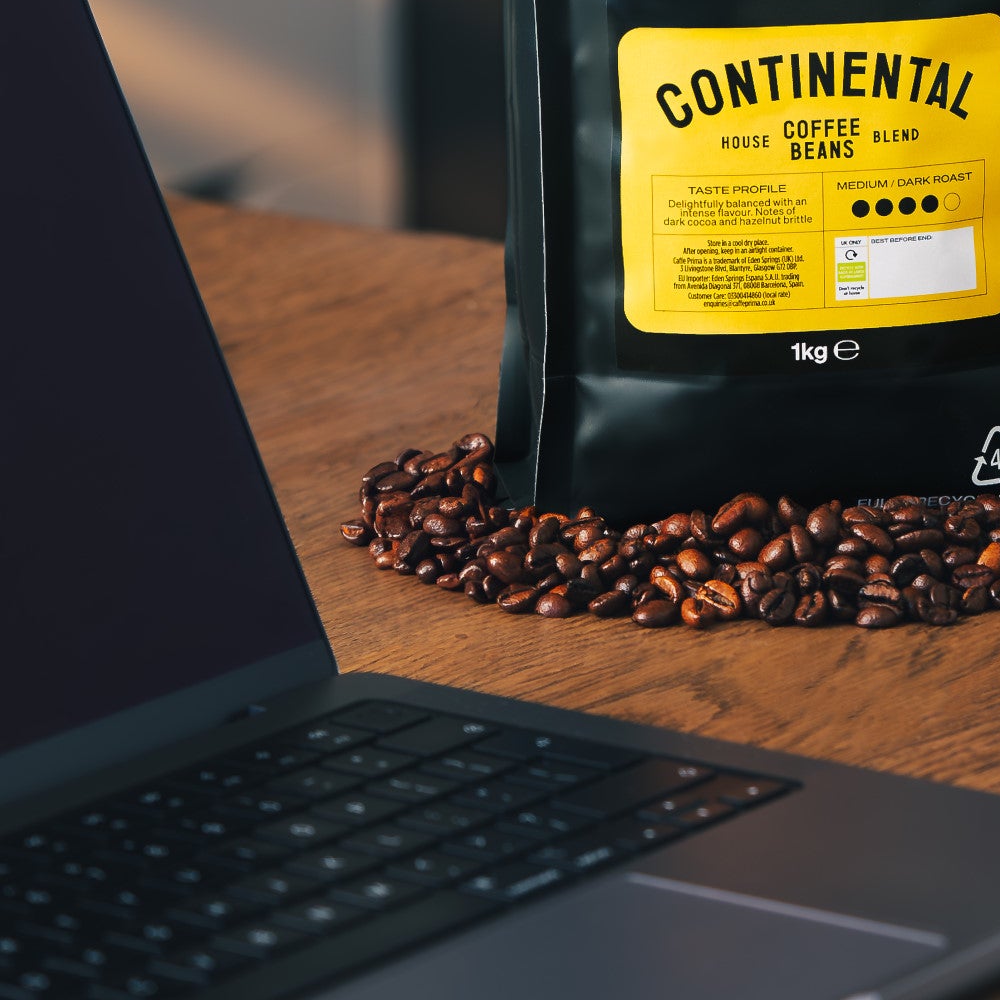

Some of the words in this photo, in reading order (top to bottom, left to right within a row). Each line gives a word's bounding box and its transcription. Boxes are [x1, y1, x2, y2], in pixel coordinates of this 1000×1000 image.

[656, 51, 974, 128] CONTINENTAL
[783, 118, 860, 140] COFFEE
[722, 135, 770, 149] HOUSE
[873, 128, 919, 143] BLEND
[791, 140, 854, 160] BEANS
[837, 180, 888, 190] MEDIUM
[898, 176, 930, 187] DARK
[934, 172, 972, 182] ROAST
[688, 186, 729, 195] TASTE
[733, 184, 786, 194] PROFILE
[669, 199, 724, 209] Delightfully
[726, 198, 770, 208] balanced
[680, 209, 715, 217] intense
[718, 208, 752, 217] flavour.
[756, 207, 783, 216] Notes
[664, 218, 685, 226] dark
[719, 217, 736, 225] and
[740, 216, 780, 225] hazelnut
[783, 215, 812, 224] brittle
[762, 256, 780, 264] Springs
[781, 273, 800, 281] trading
[791, 342, 828, 364] 1kg
